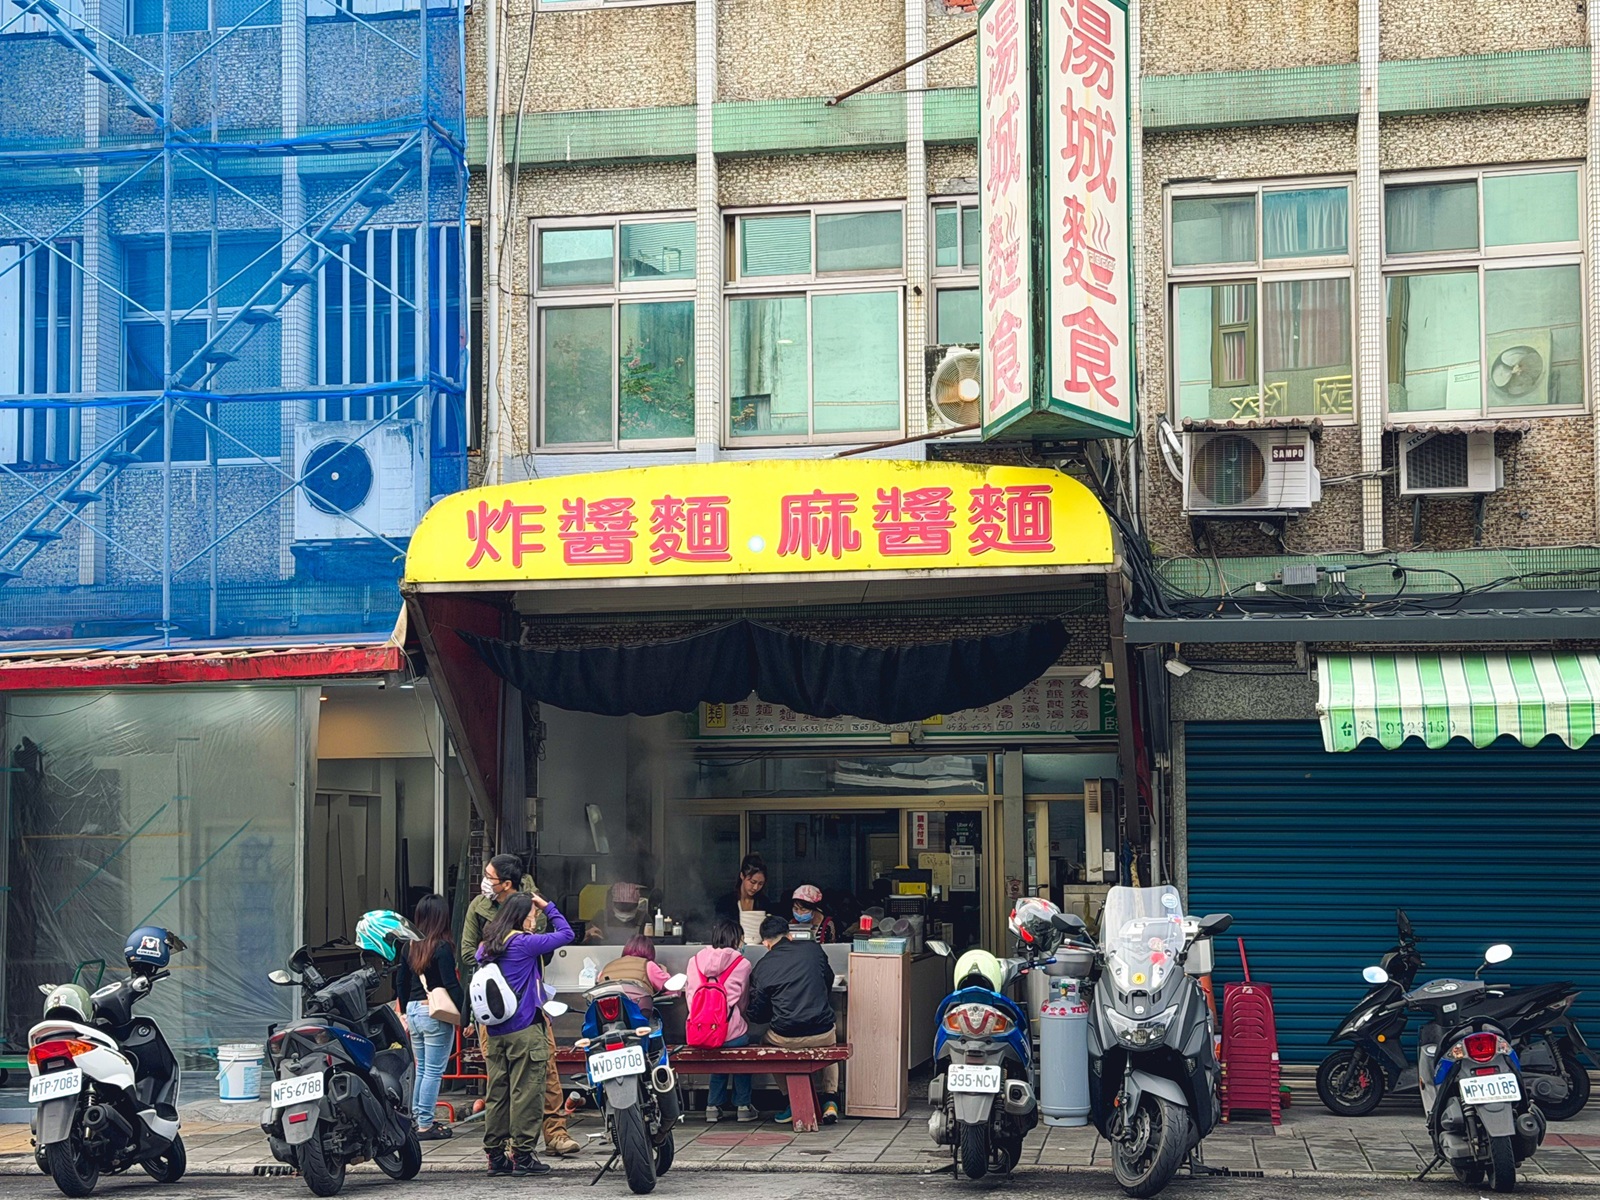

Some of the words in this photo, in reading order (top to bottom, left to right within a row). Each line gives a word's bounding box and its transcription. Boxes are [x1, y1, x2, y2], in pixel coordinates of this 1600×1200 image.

[1060, 0, 1119, 407] 湯城麵食
[1407, 432, 1427, 447] TECO
[1273, 449, 1304, 459] SAMPO
[467, 494, 732, 569] 炸醬麵
[777, 484, 1055, 560] 麻醬麵
[591, 1053, 643, 1077] MVD-8708
[31, 1074, 80, 1098] MTP-7083
[273, 1079, 322, 1103] NFS-6788
[950, 1073, 998, 1088] 395-NCV
[1463, 1080, 1517, 1099] MPY-0185
